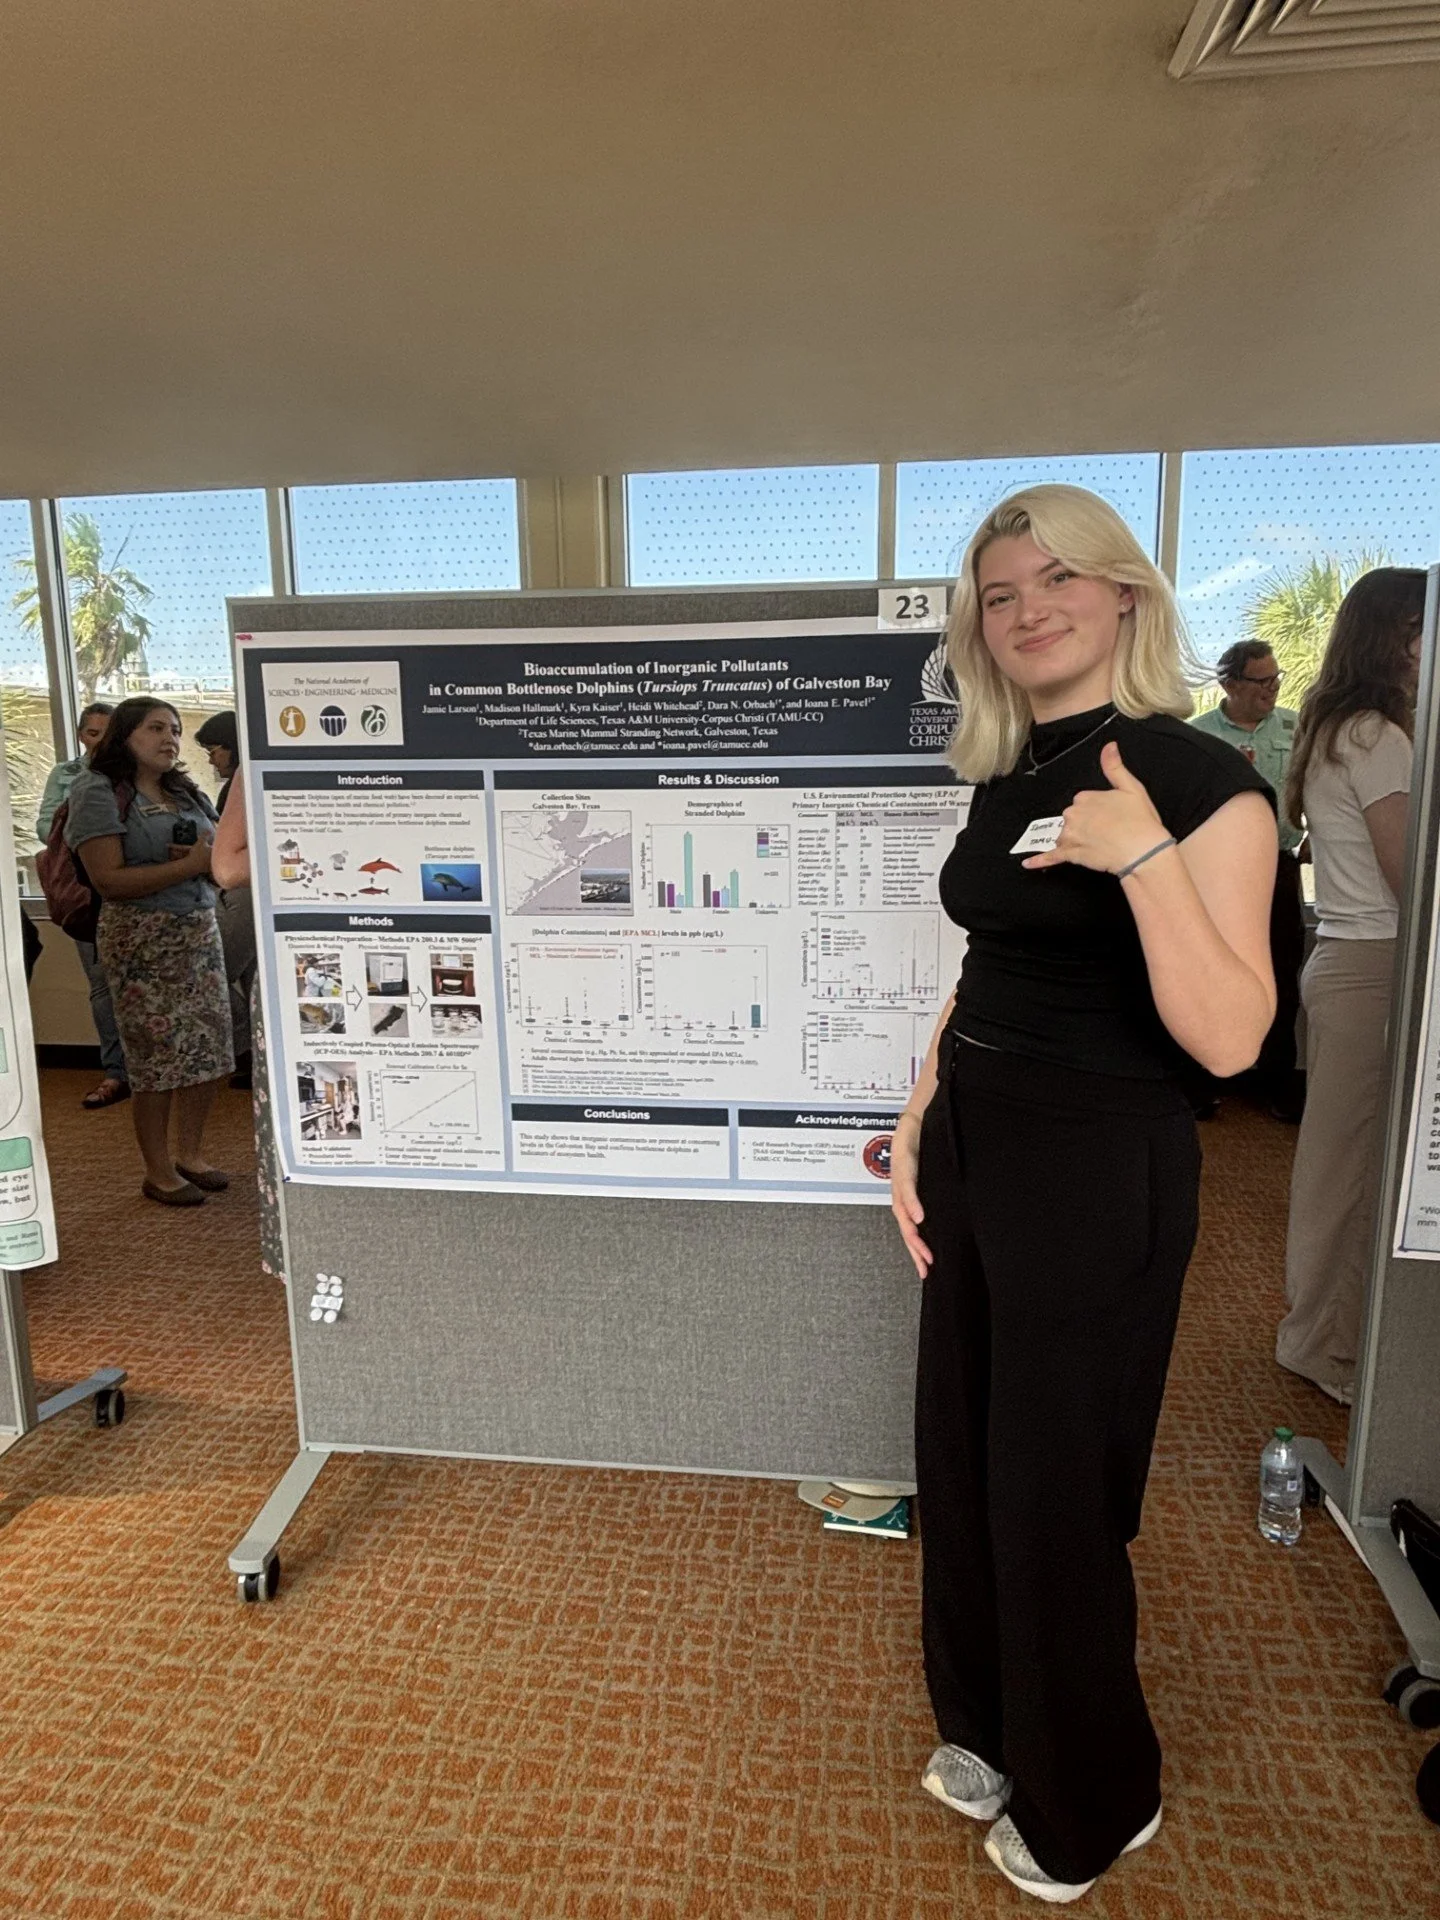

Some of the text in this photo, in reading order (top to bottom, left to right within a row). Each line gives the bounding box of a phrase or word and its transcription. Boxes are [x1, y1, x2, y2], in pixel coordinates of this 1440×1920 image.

[895, 594, 930, 619] 23
[523, 659, 789, 677] Bioaccumulation of Inorganic Pollutants
[294, 676, 370, 686] The National Academies of
[428, 675, 892, 697] in Common Bottlenose Dolphins (Tursiops Truncatus) of Galveston Bay
[268, 687, 398, 697] SCIENCES ENGINEERING MEDICINE
[422, 704, 446, 713] Jamie
[485, 703, 521, 713] Madison
[570, 703, 590, 714] Kyra
[628, 701, 652, 711] Heidi
[707, 701, 728, 710] Dara
[730, 700, 741, 709] N.
[786, 699, 802, 709] and
[804, 698, 828, 708] Ioana
[831, 698, 841, 707] E.
[910, 707, 938, 716] TEXAS
[529, 716, 540, 725] of
[540, 716, 557, 725] Life
[559, 716, 599, 726] Sciences,
[600, 715, 626, 725] Texas
[627, 715, 653, 725] A&M
[654, 713, 733, 726] University-Corpus
[735, 712, 764, 723] Christi
[766, 712, 824, 723] (TAMU-CC)
[549, 728, 579, 738] Marine
[580, 728, 618, 738] Mammal
[619, 728, 661, 739] Stranding
[662, 727, 703, 738] Network,
[704, 726, 751, 737] Galveston,
[752, 726, 778, 736] Texas
[909, 724, 955, 735] CORPU
[337, 775, 403, 785] Introduction
[658, 773, 780, 786] Results & Discussion
[349, 916, 394, 926] Methods
[584, 1108, 651, 1121] Conclusions
[12, 1173, 28, 1182] eye
[12, 1184, 29, 1192] size
[15, 1194, 31, 1204] but
